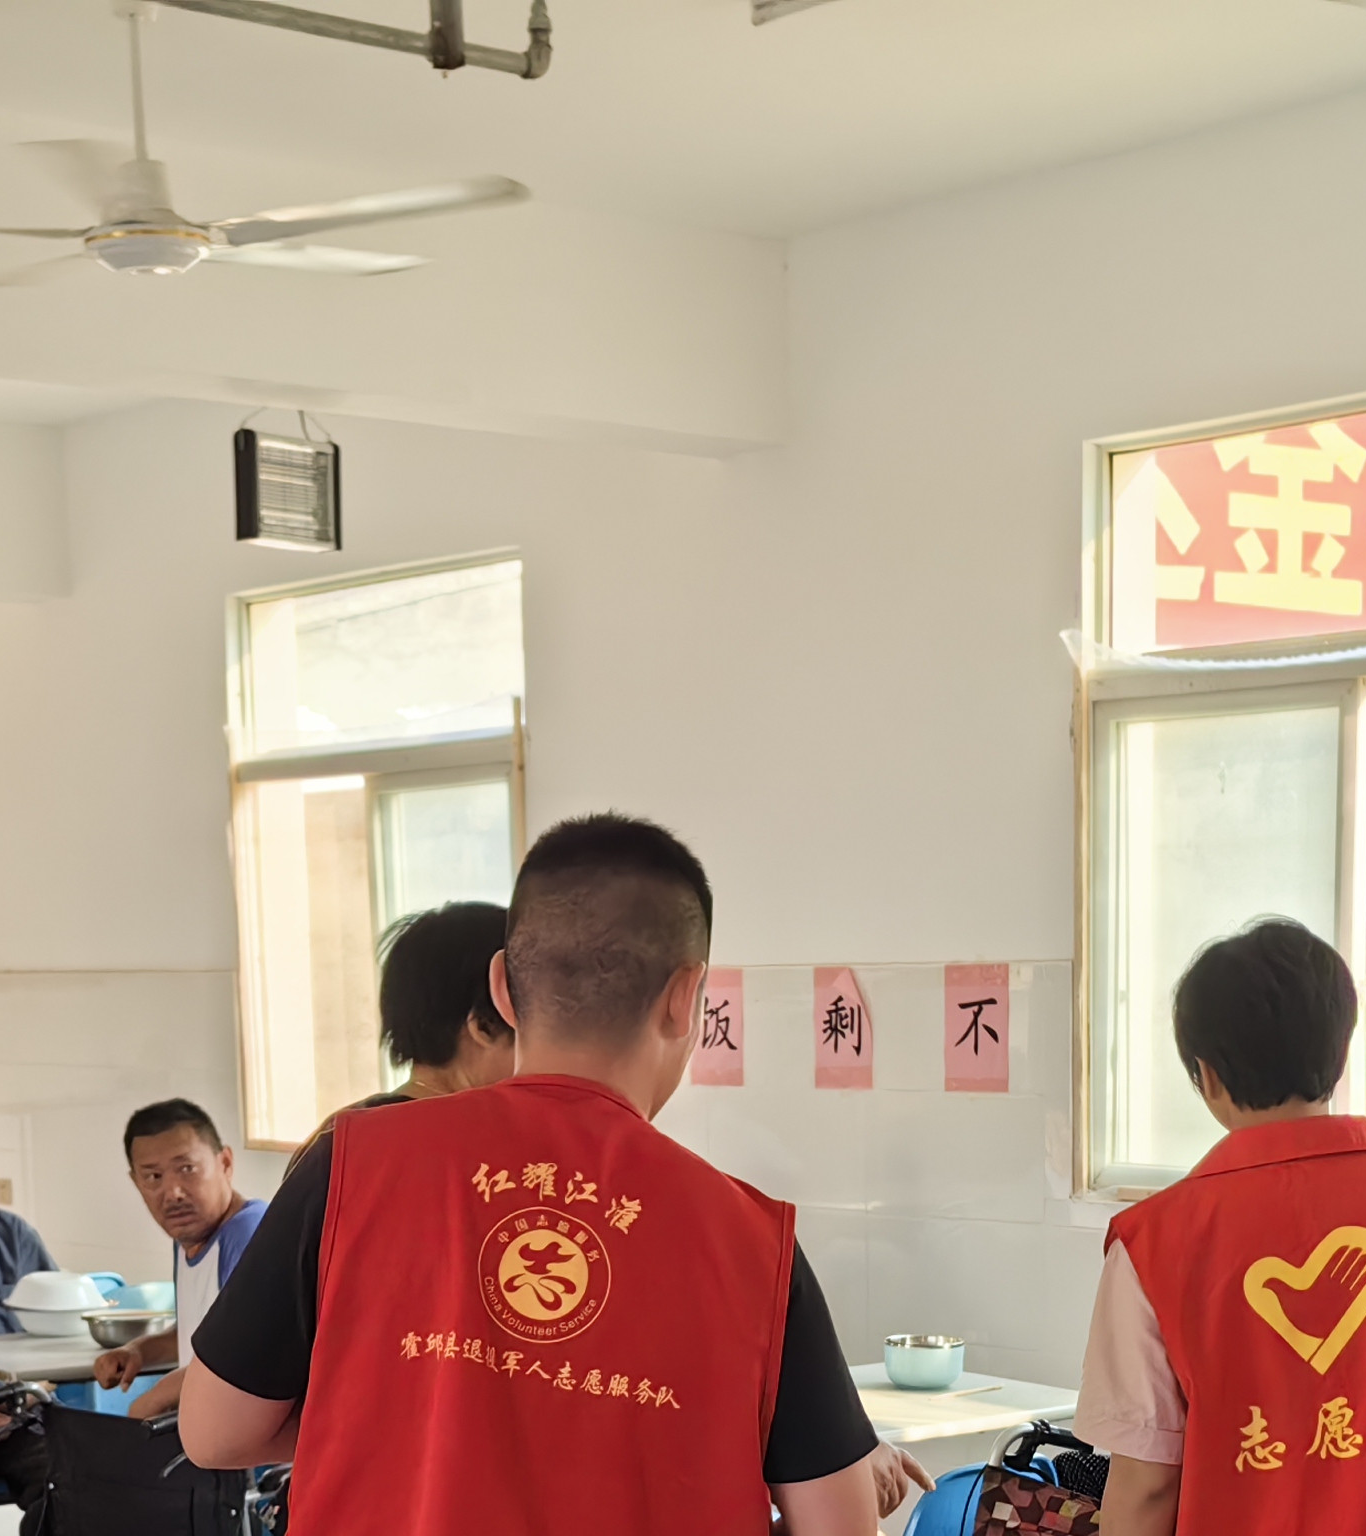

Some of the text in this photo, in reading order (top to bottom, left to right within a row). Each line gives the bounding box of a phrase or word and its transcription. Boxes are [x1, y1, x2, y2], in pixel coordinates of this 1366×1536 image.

[821, 994, 863, 1057] 剩
[954, 997, 1000, 1056] 不
[484, 1276, 597, 1336] China Volunteer Service
